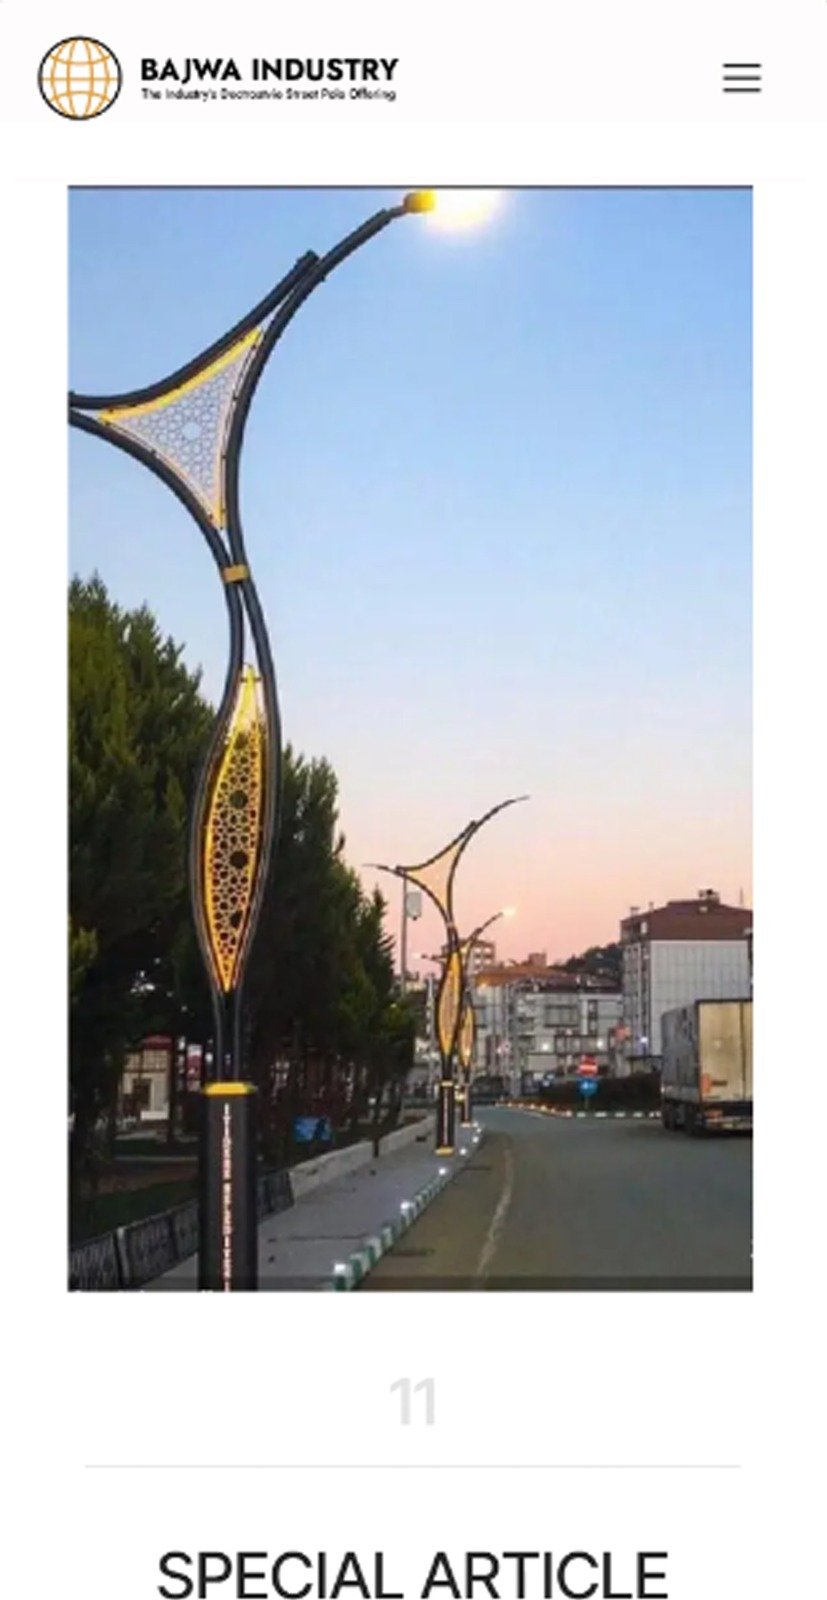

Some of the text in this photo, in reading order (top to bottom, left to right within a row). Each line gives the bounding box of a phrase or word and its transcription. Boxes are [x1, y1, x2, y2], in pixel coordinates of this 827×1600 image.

[140, 58, 399, 84] BAJWA INDUSTRY
[140, 87, 162, 100] The
[389, 1377, 437, 1426] 11
[157, 1551, 669, 1600] SPECIAL ARTICLE
